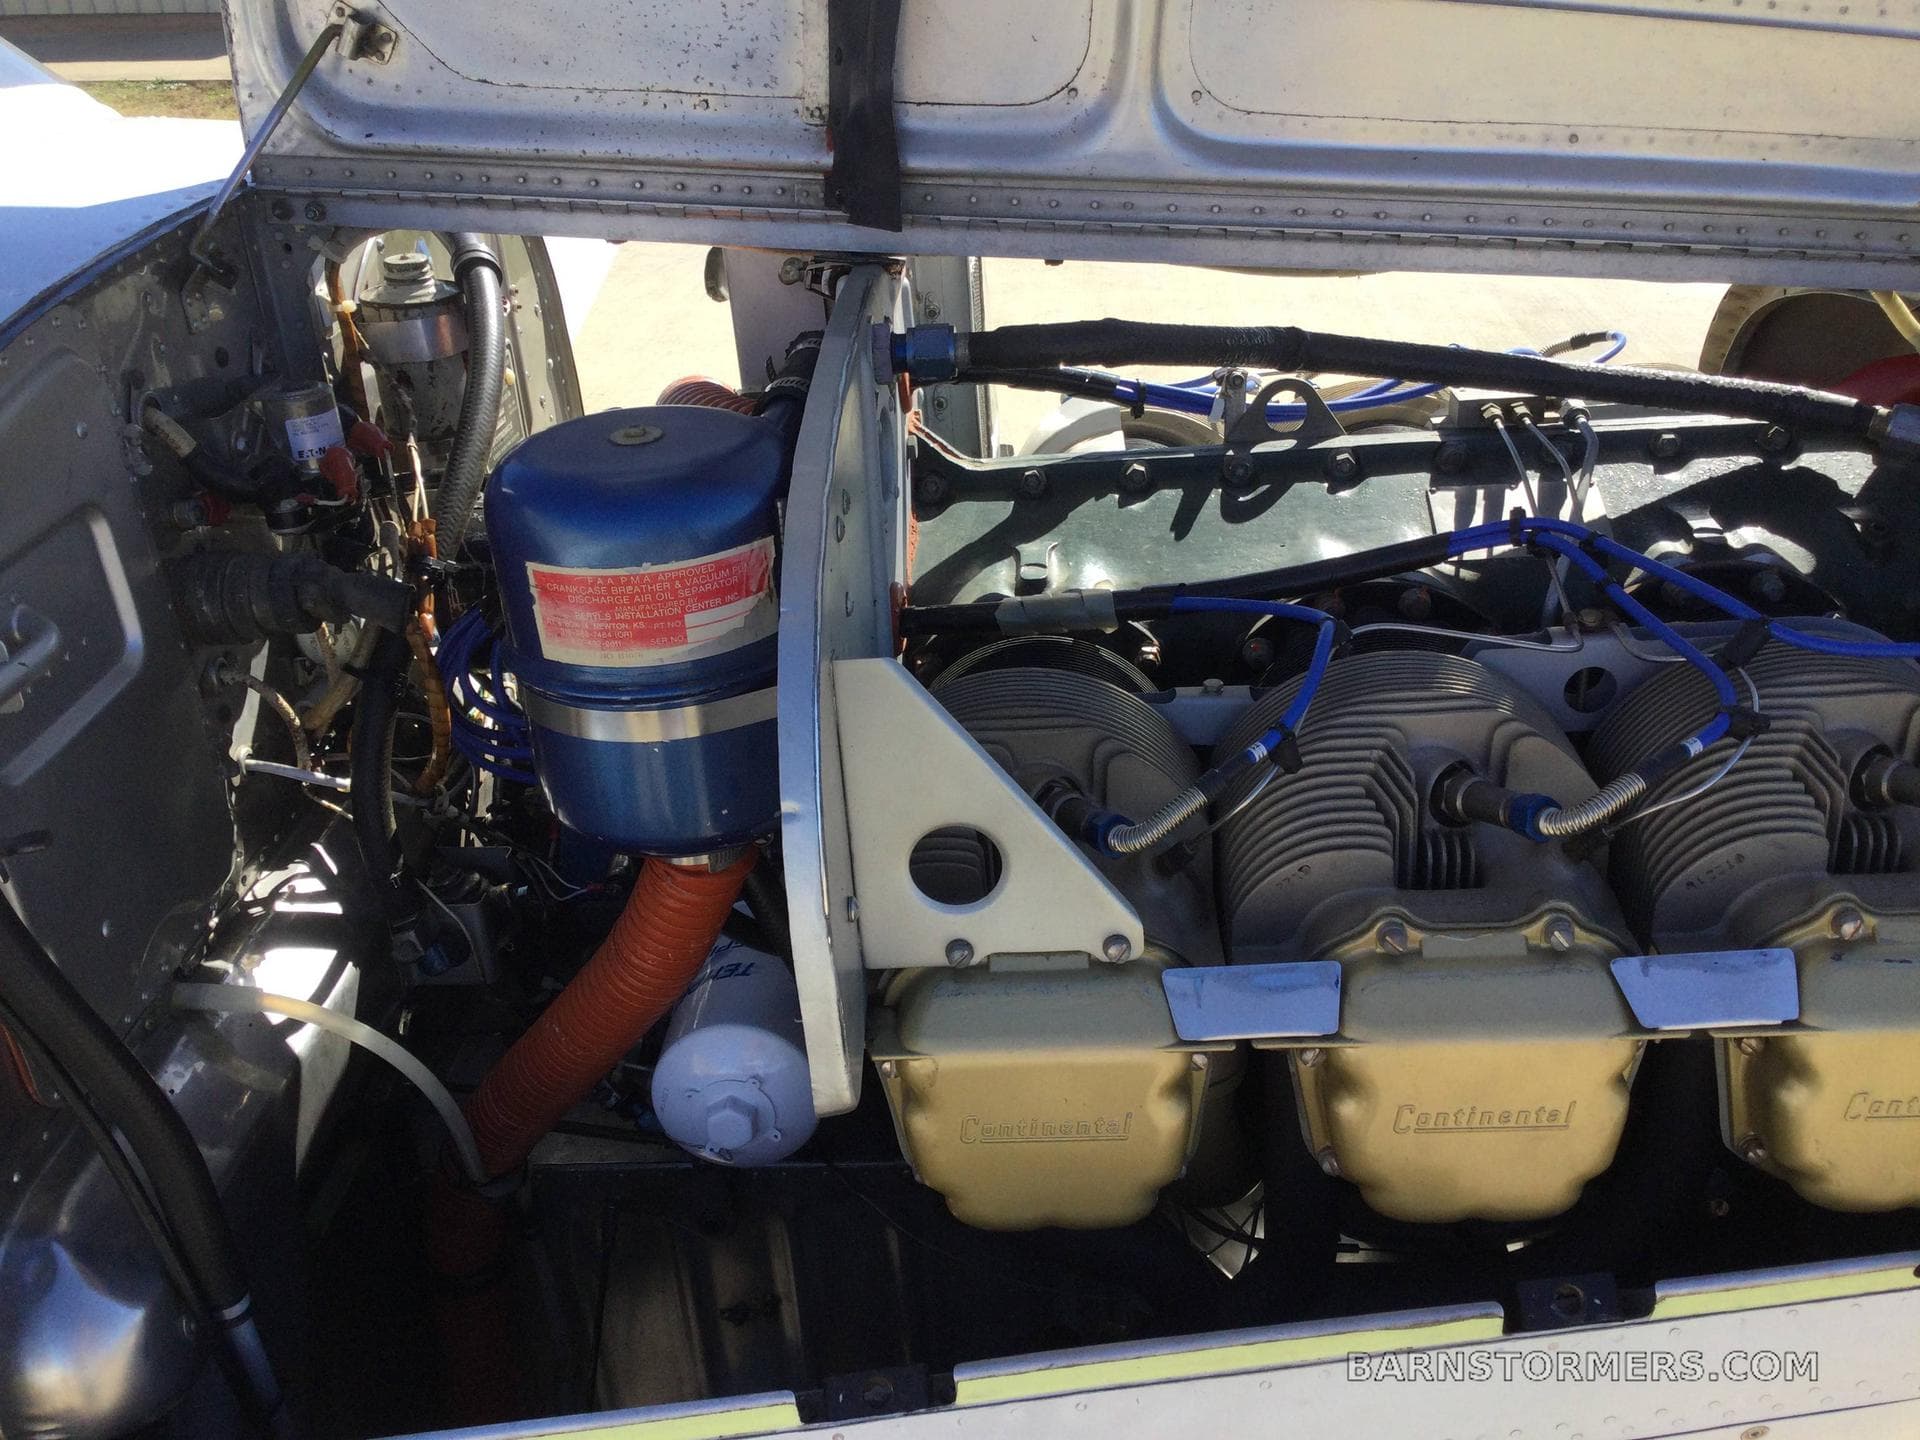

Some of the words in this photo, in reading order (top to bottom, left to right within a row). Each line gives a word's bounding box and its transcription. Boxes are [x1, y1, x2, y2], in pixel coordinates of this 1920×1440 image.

[546, 583, 608, 595] CRANKCASE
[611, 582, 670, 595] BREATHER
[675, 580, 682, 589] &
[685, 568, 729, 586] VACUUM
[658, 563, 715, 580] APPROVED
[568, 594, 631, 605] DISCHARGE
[634, 593, 652, 603] AIR
[656, 592, 674, 601] OIL
[678, 575, 738, 598] SEPARATOR
[614, 605, 681, 620] INSTALLATION
[685, 597, 721, 613] CENTER
[615, 598, 685, 611] MANUFACTURED
[688, 596, 698, 605] BY
[654, 622, 665, 630] PT
[960, 1111, 1133, 1144] Continental
[1393, 1100, 1577, 1135] Continental
